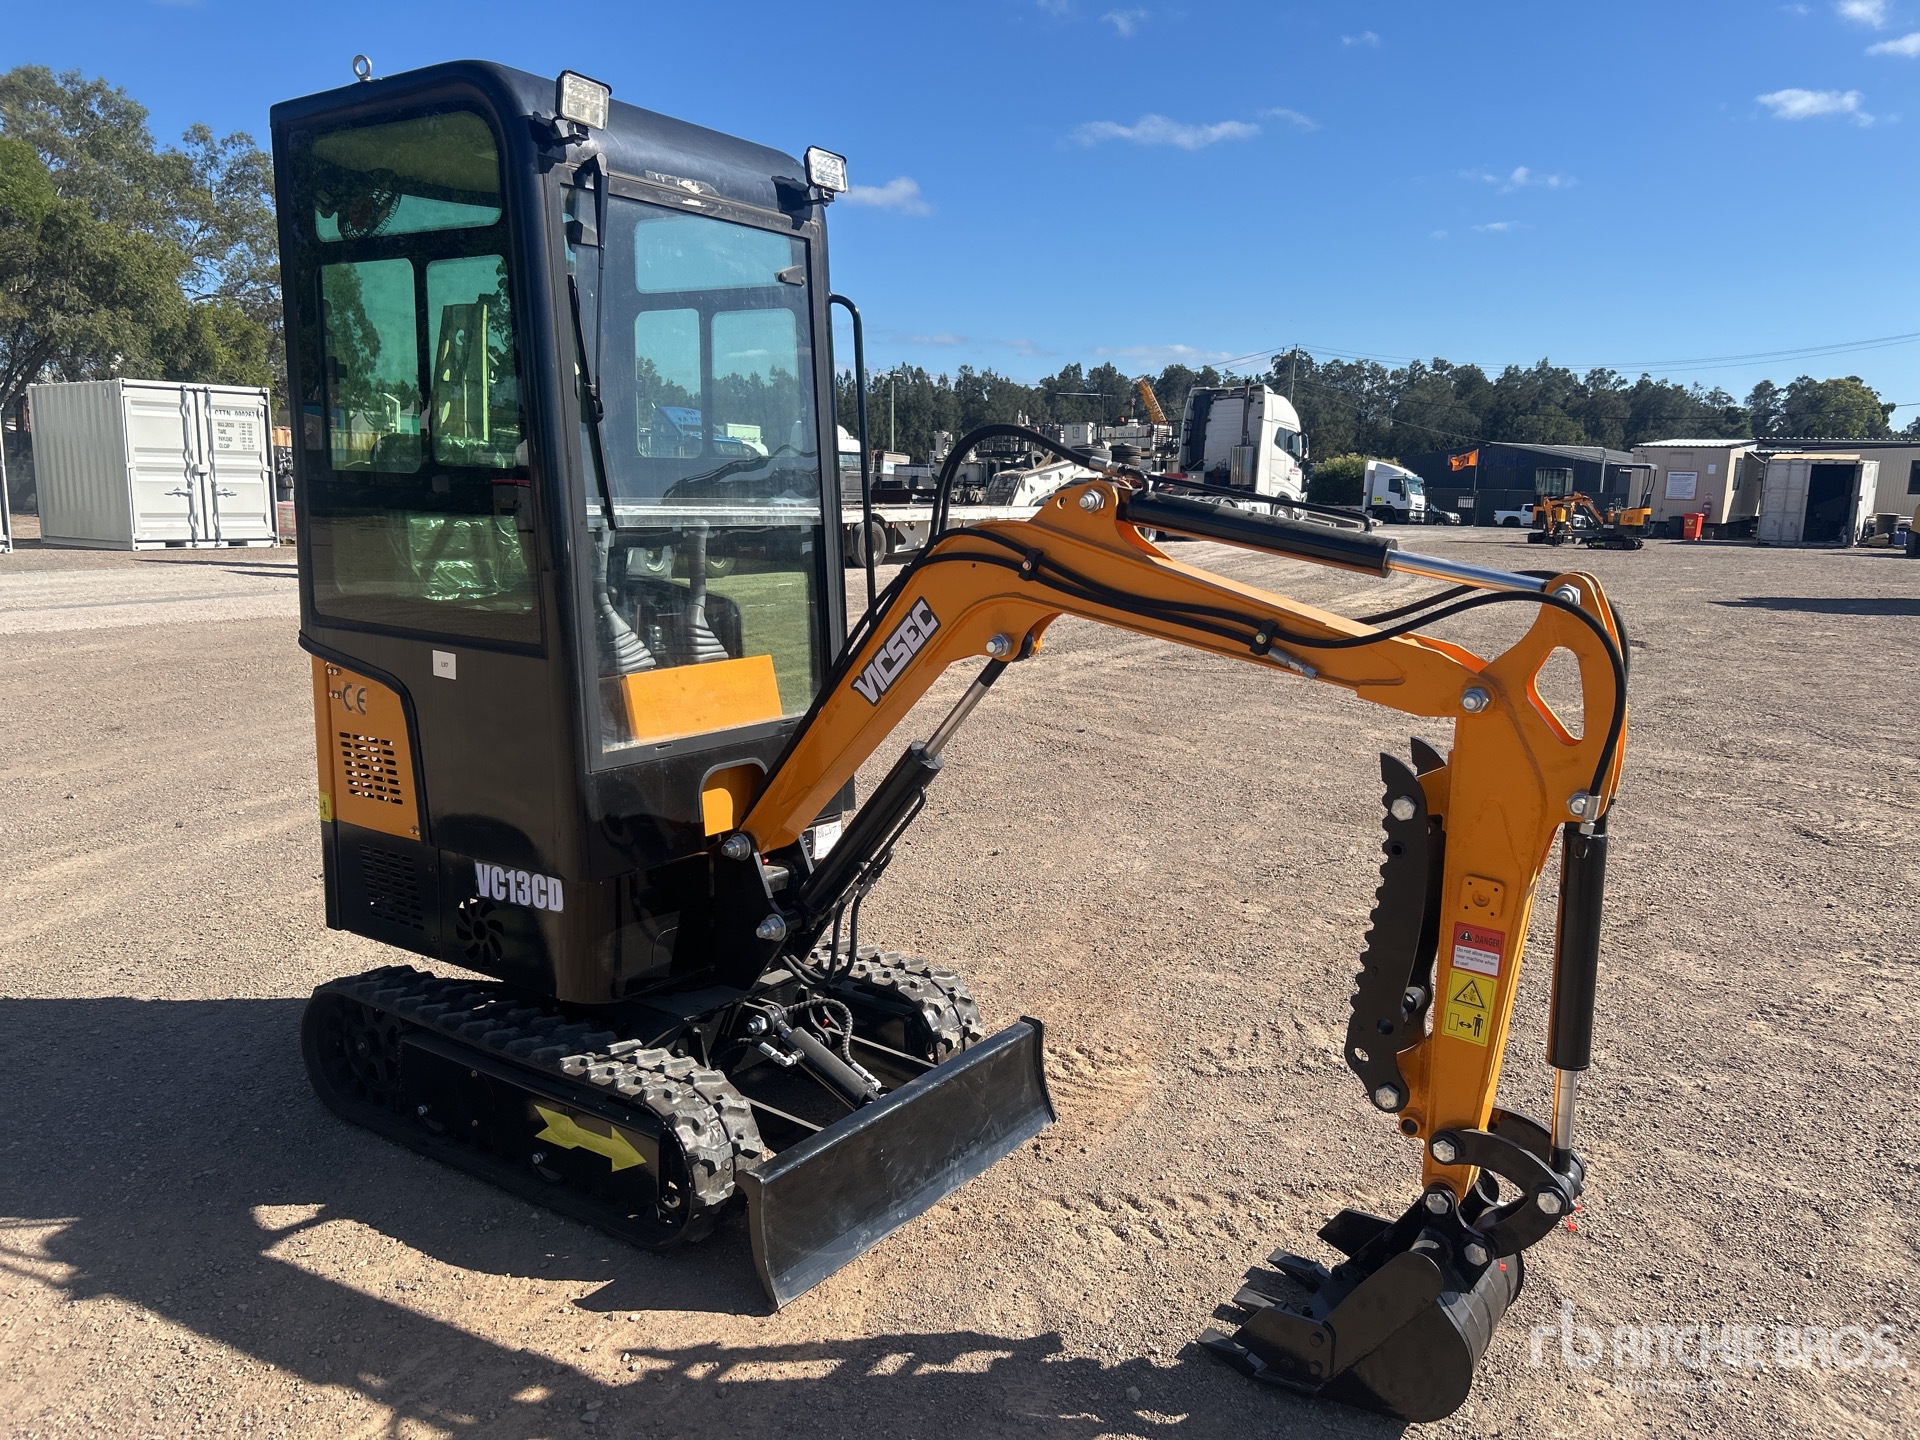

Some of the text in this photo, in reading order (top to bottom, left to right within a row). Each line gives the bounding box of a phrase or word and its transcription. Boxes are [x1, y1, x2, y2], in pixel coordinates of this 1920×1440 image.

[851, 597, 940, 706] VICSEC
[342, 684, 367, 715] CE
[474, 861, 564, 912] VC13CD
[1483, 953, 1498, 961] people
